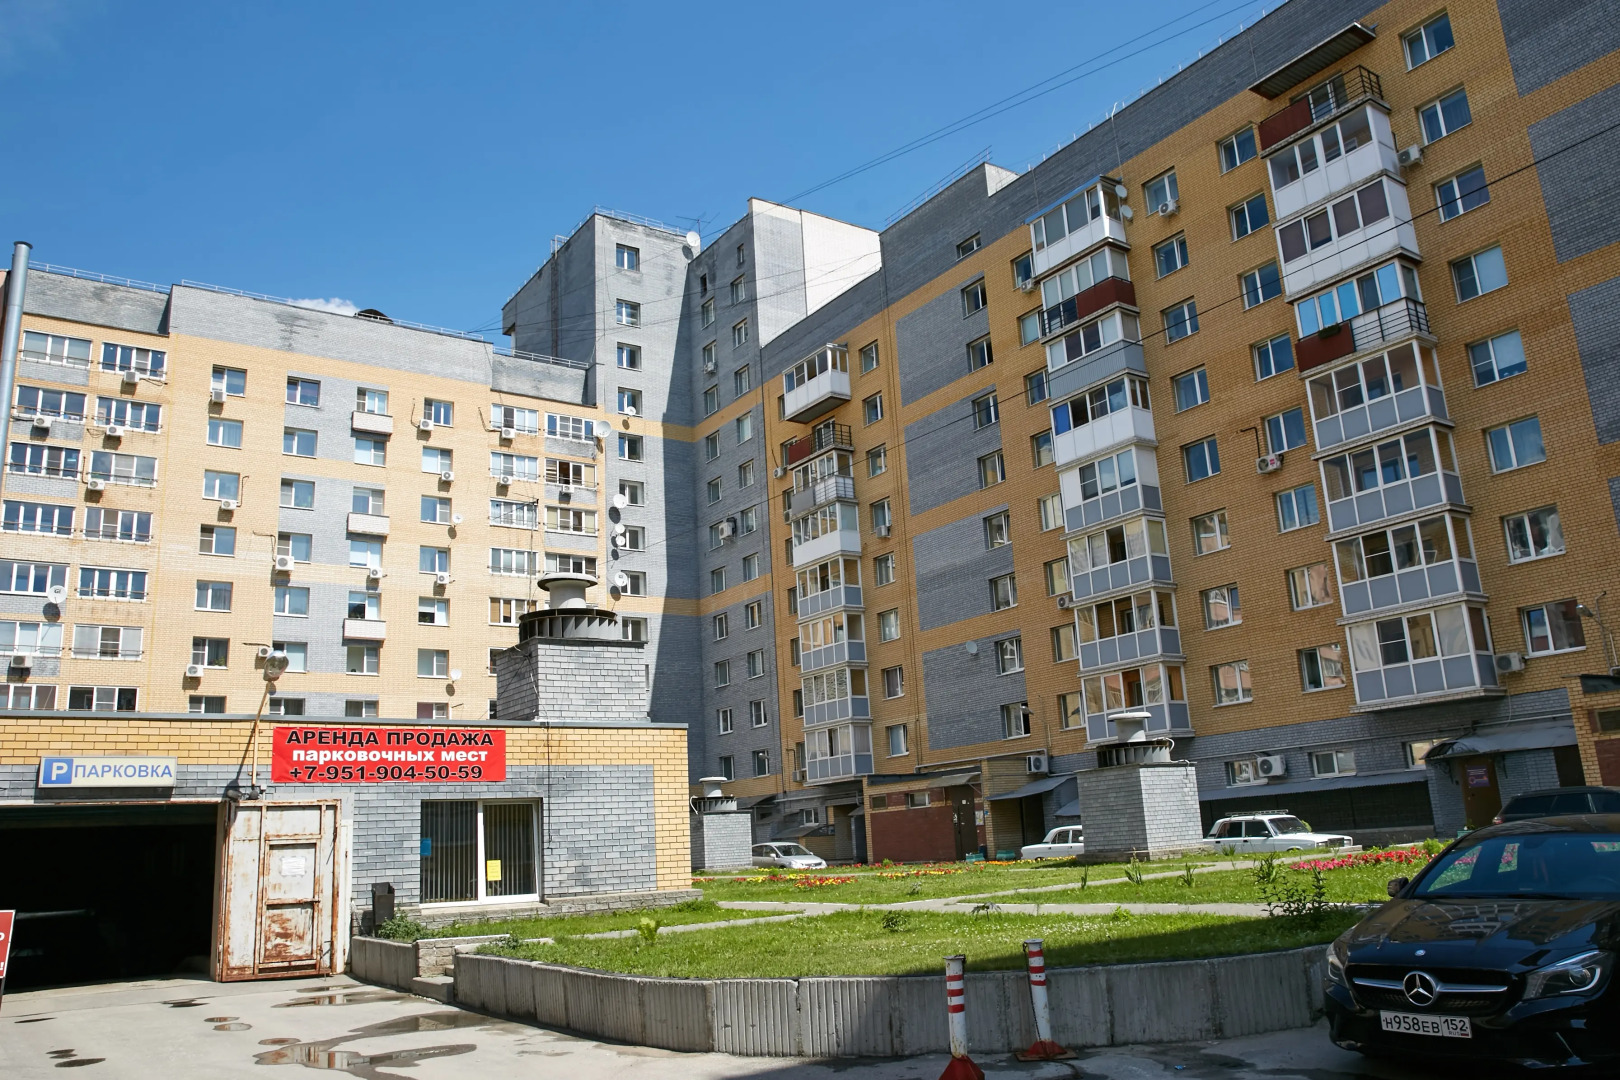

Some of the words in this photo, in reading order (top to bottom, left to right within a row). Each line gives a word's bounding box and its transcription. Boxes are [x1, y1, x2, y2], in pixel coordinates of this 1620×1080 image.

[286, 730, 379, 747] АРЕНДА
[387, 731, 494, 748] ПРОДАЖА
[292, 749, 435, 765] парковочных
[441, 751, 488, 762] мест
[74, 764, 173, 778] ПАРКОВКА
[290, 765, 483, 780] +7-951-904-50-59
[1443, 1018, 1467, 1032] 152
